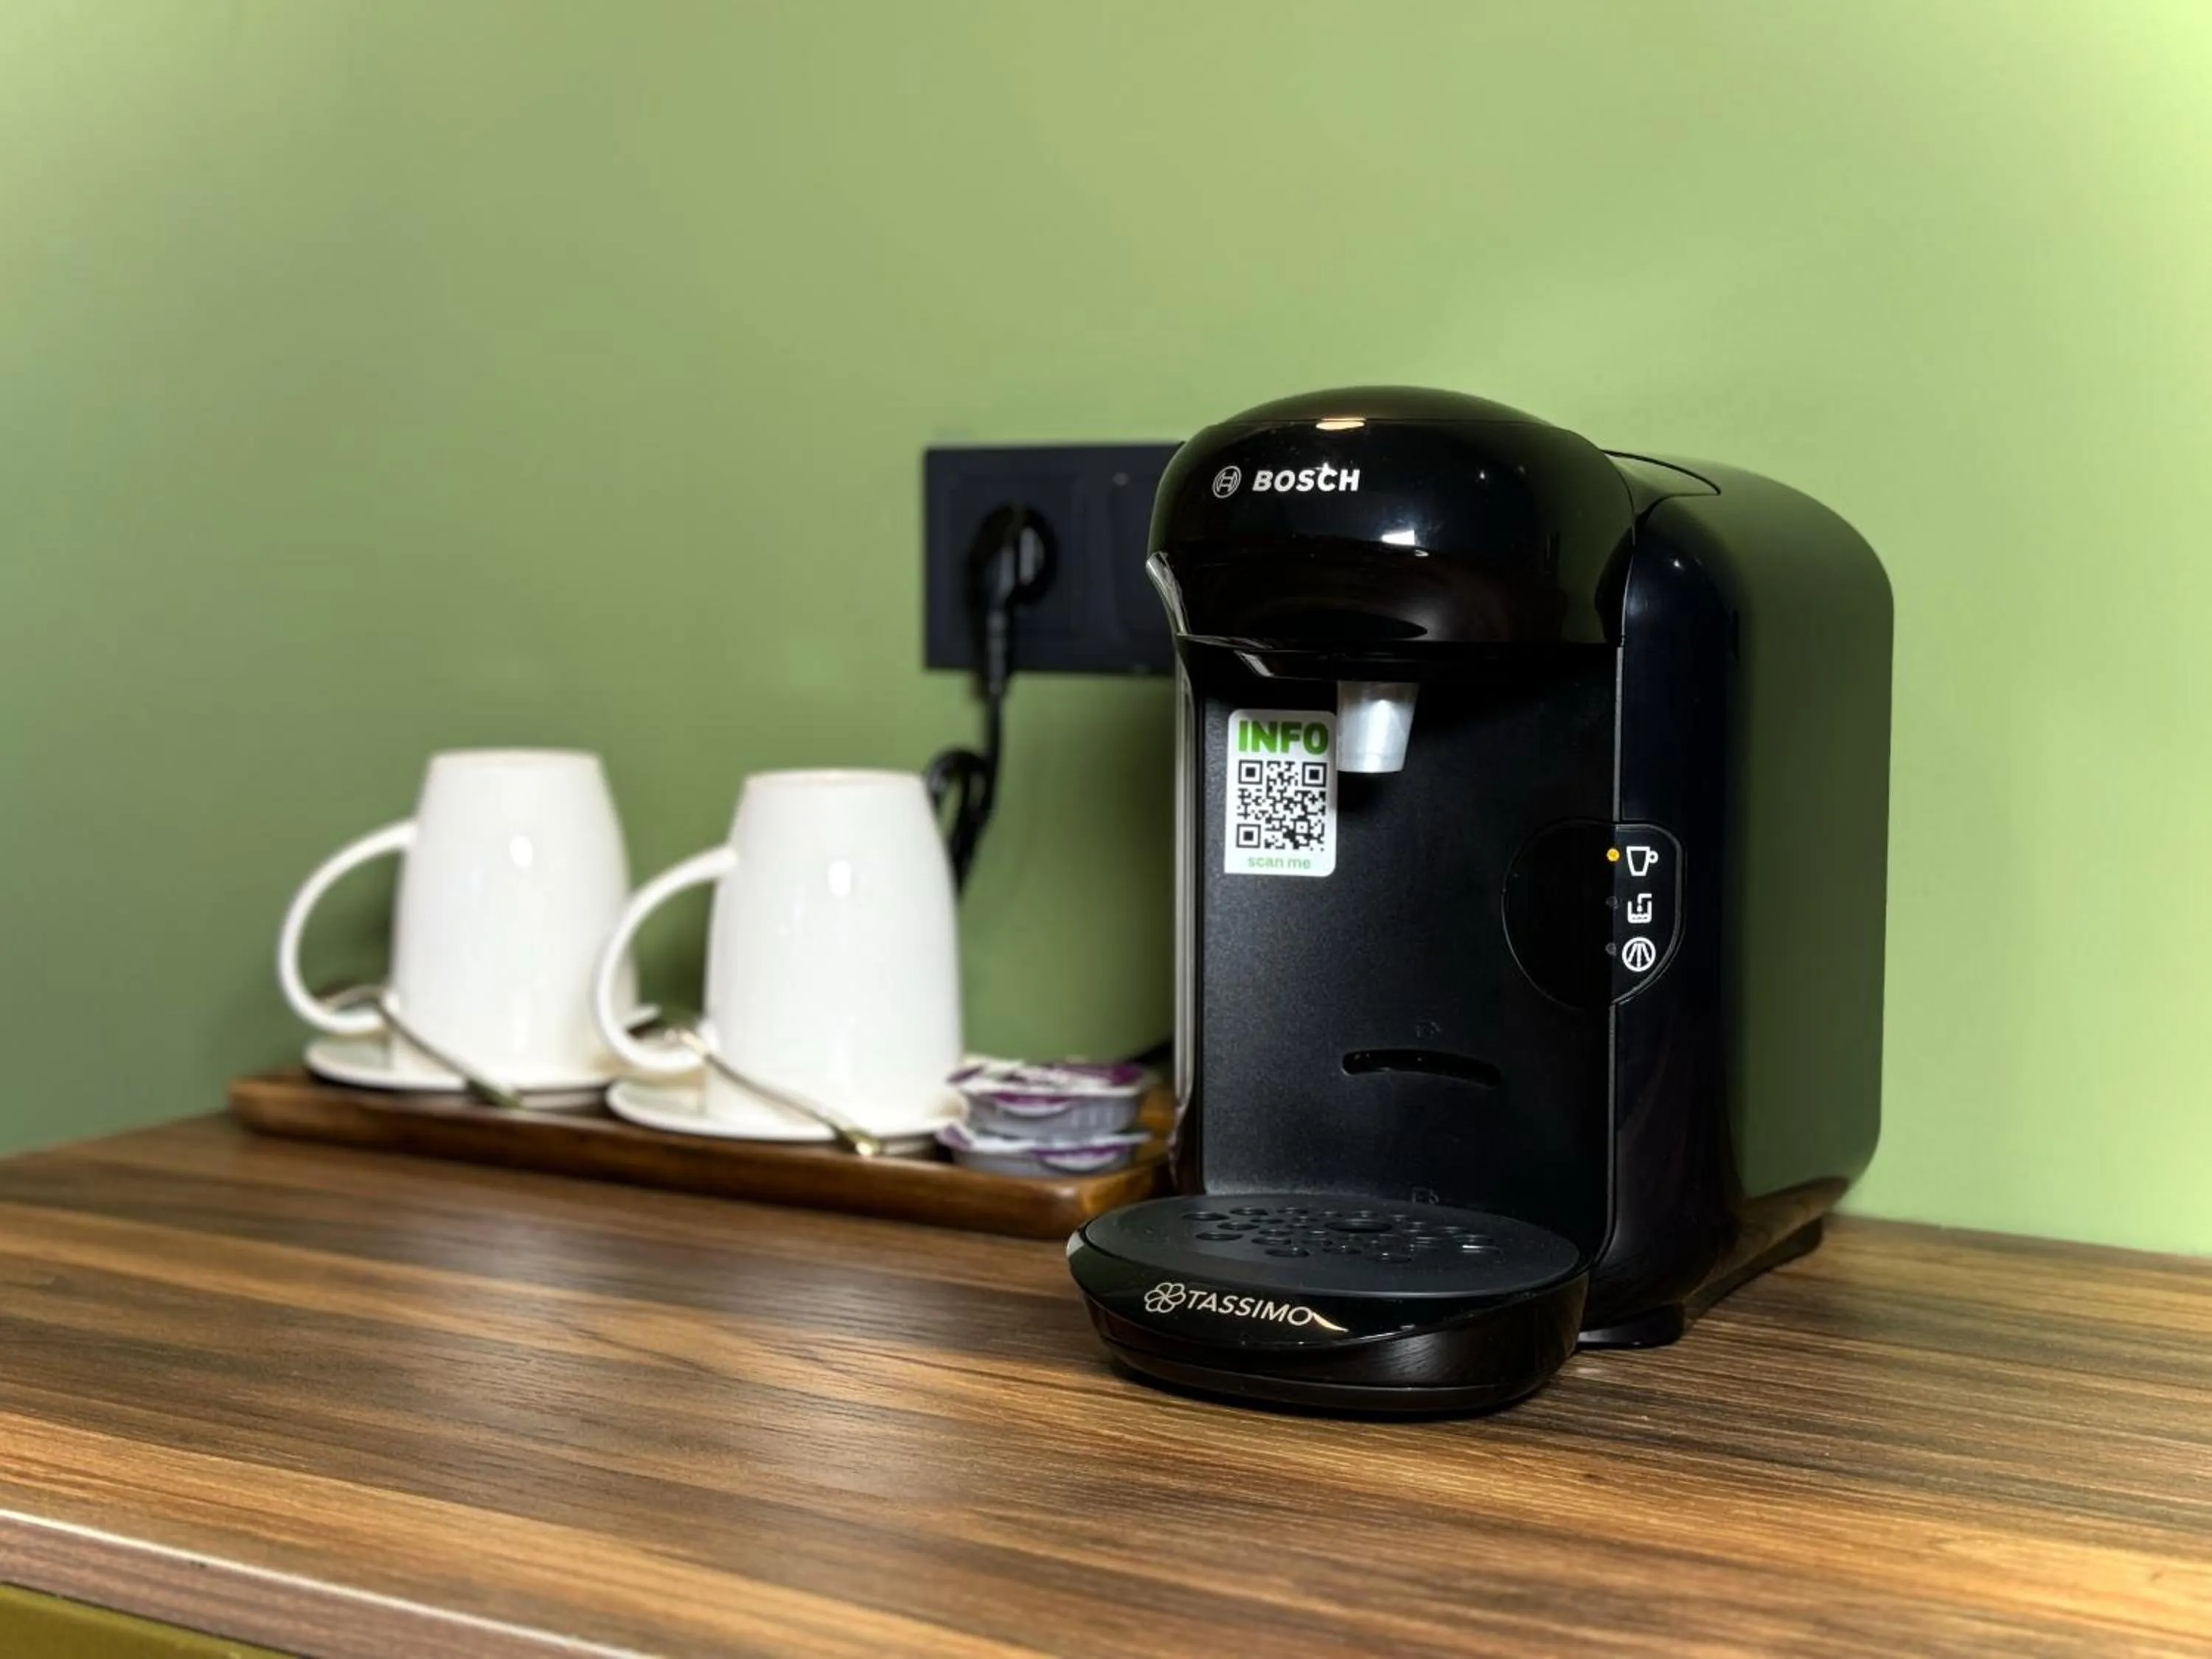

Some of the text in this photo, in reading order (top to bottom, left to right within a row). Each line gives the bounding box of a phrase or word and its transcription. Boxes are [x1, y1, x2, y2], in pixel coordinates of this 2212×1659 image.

[1252, 469, 1360, 492] BOSCH
[1238, 720, 1329, 755] INFO
[1248, 856, 1311, 869] scan me
[1187, 1290, 1312, 1326] TASSIMO
